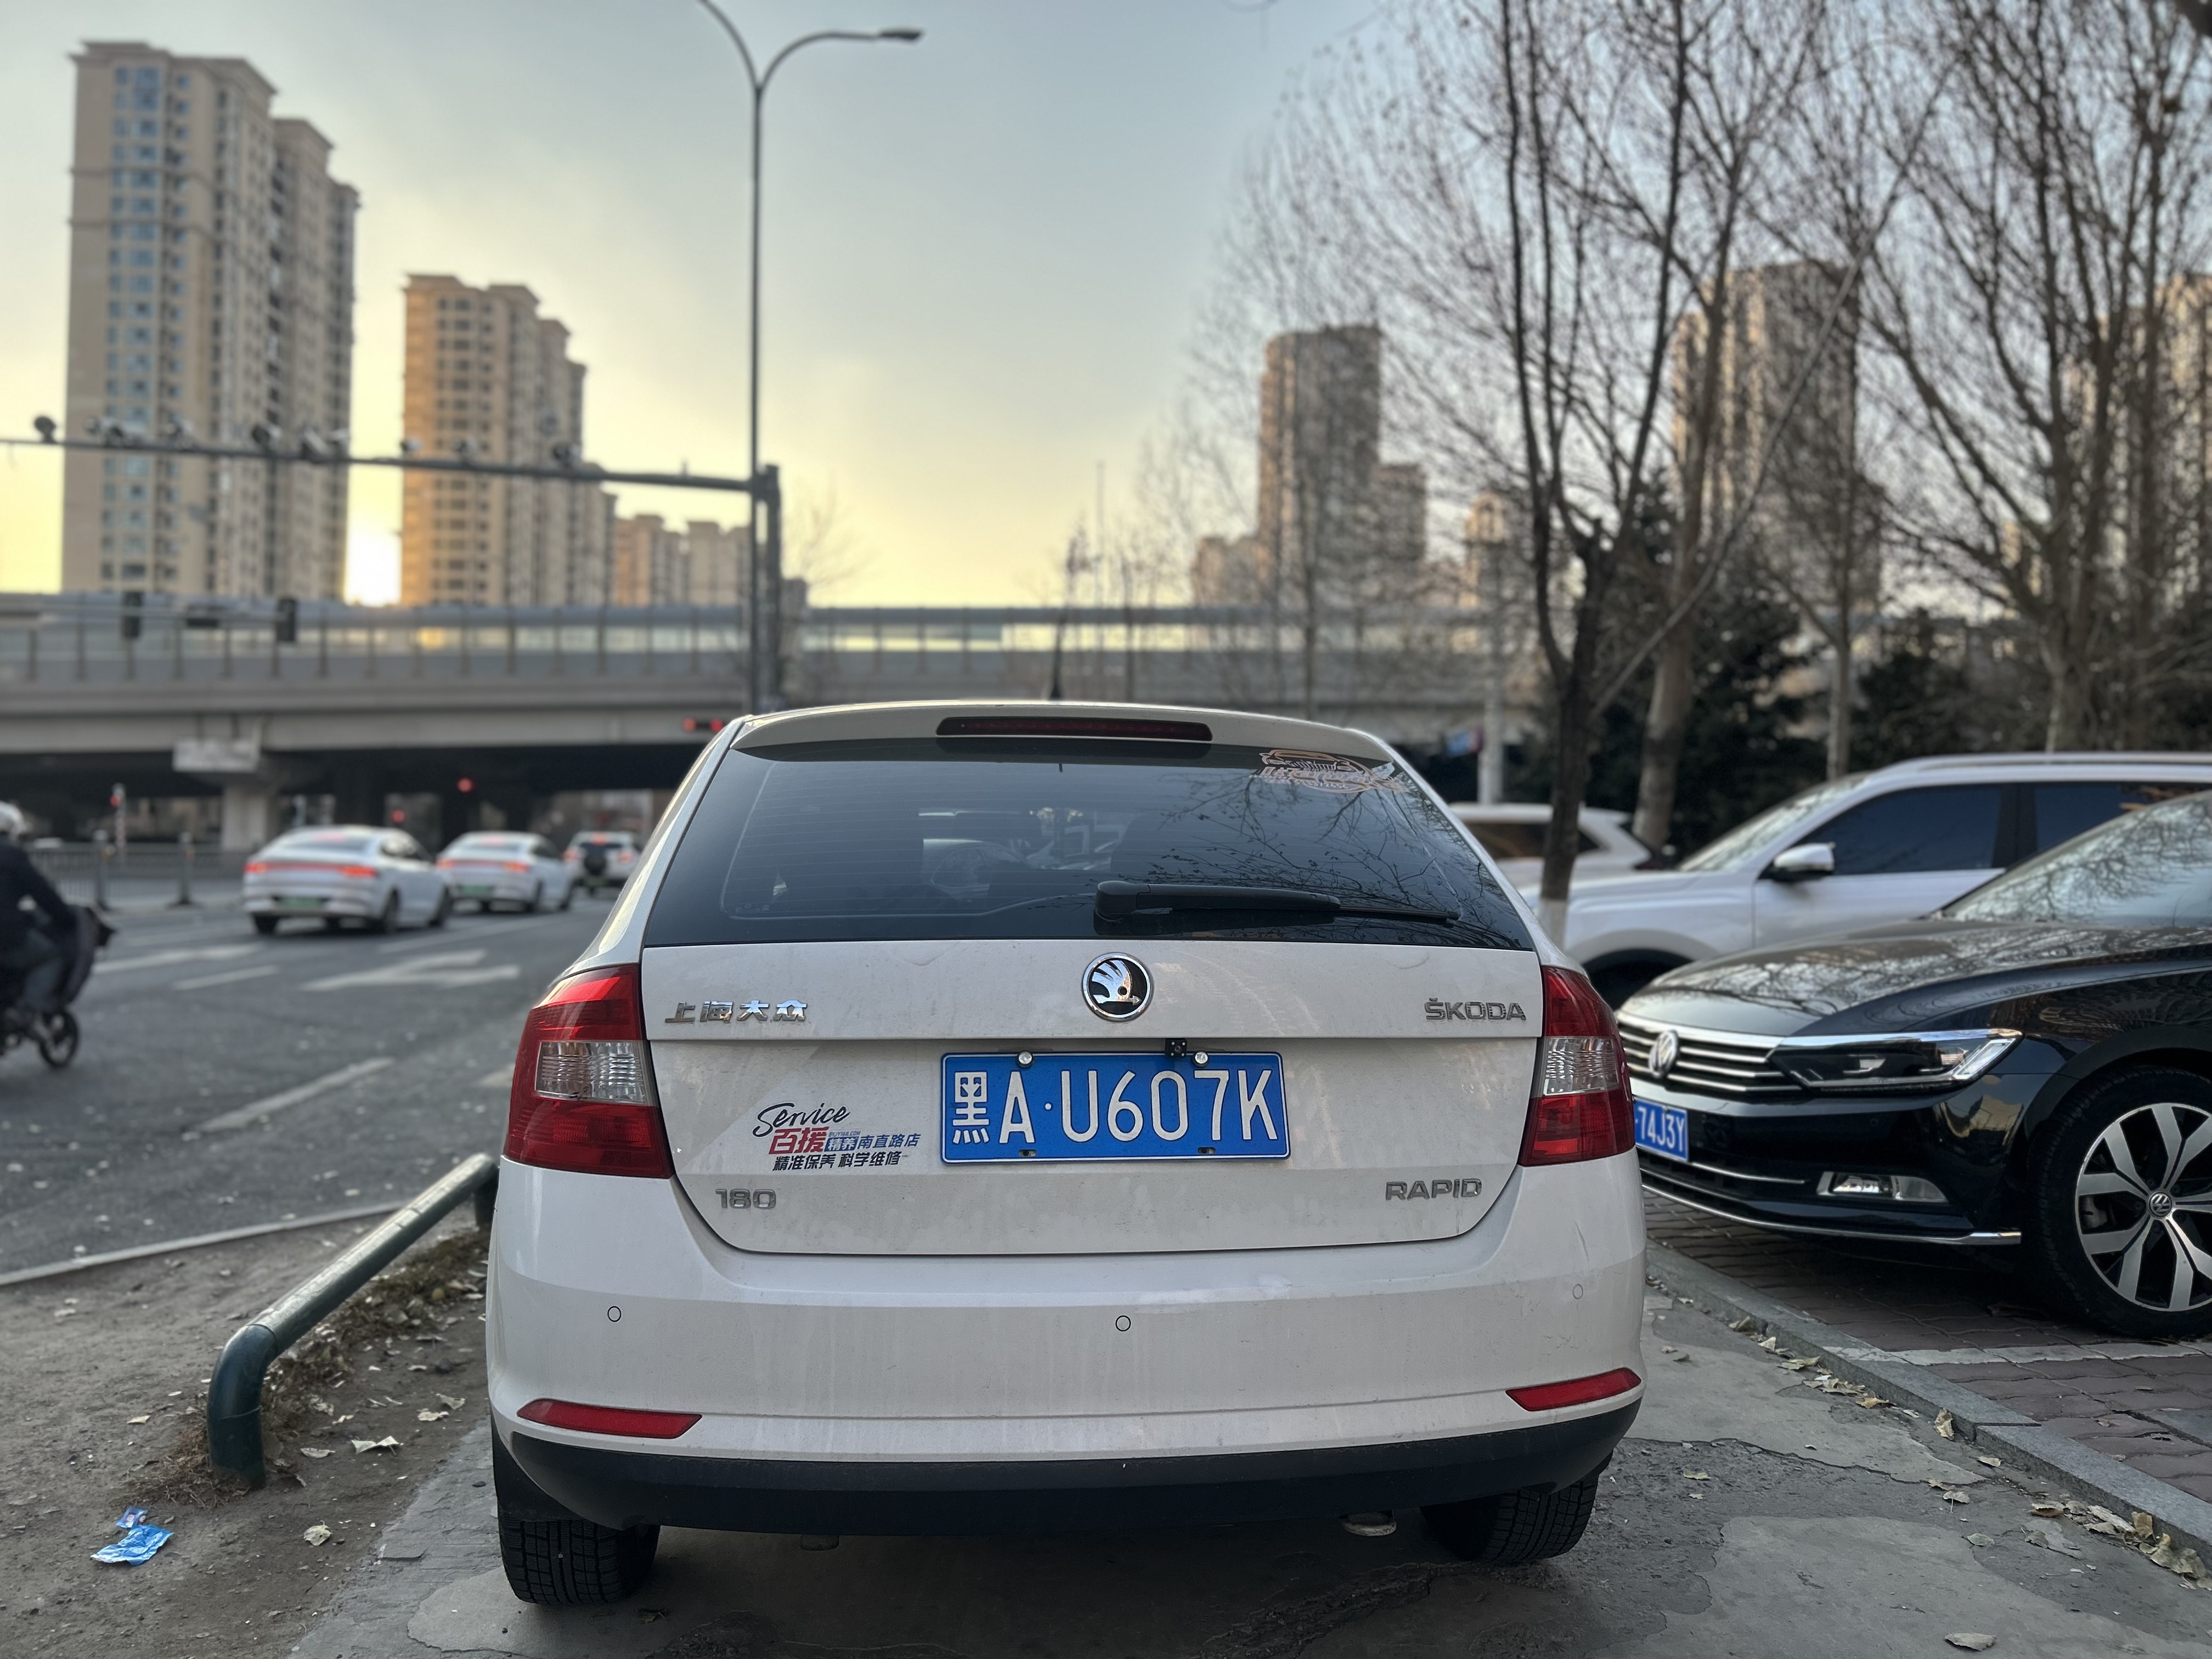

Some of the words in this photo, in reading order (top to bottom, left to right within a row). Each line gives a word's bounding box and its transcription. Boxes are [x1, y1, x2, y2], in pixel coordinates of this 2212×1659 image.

[664, 1000, 808, 1024] 上海大众
[1424, 997, 1526, 1020] ŠKODA
[752, 1102, 851, 1137] Service
[772, 1153, 837, 1171] 精准保养
[838, 1150, 902, 1168] 科学维修
[715, 1188, 776, 1209] 180
[1386, 1178, 1482, 1200] RAPID
